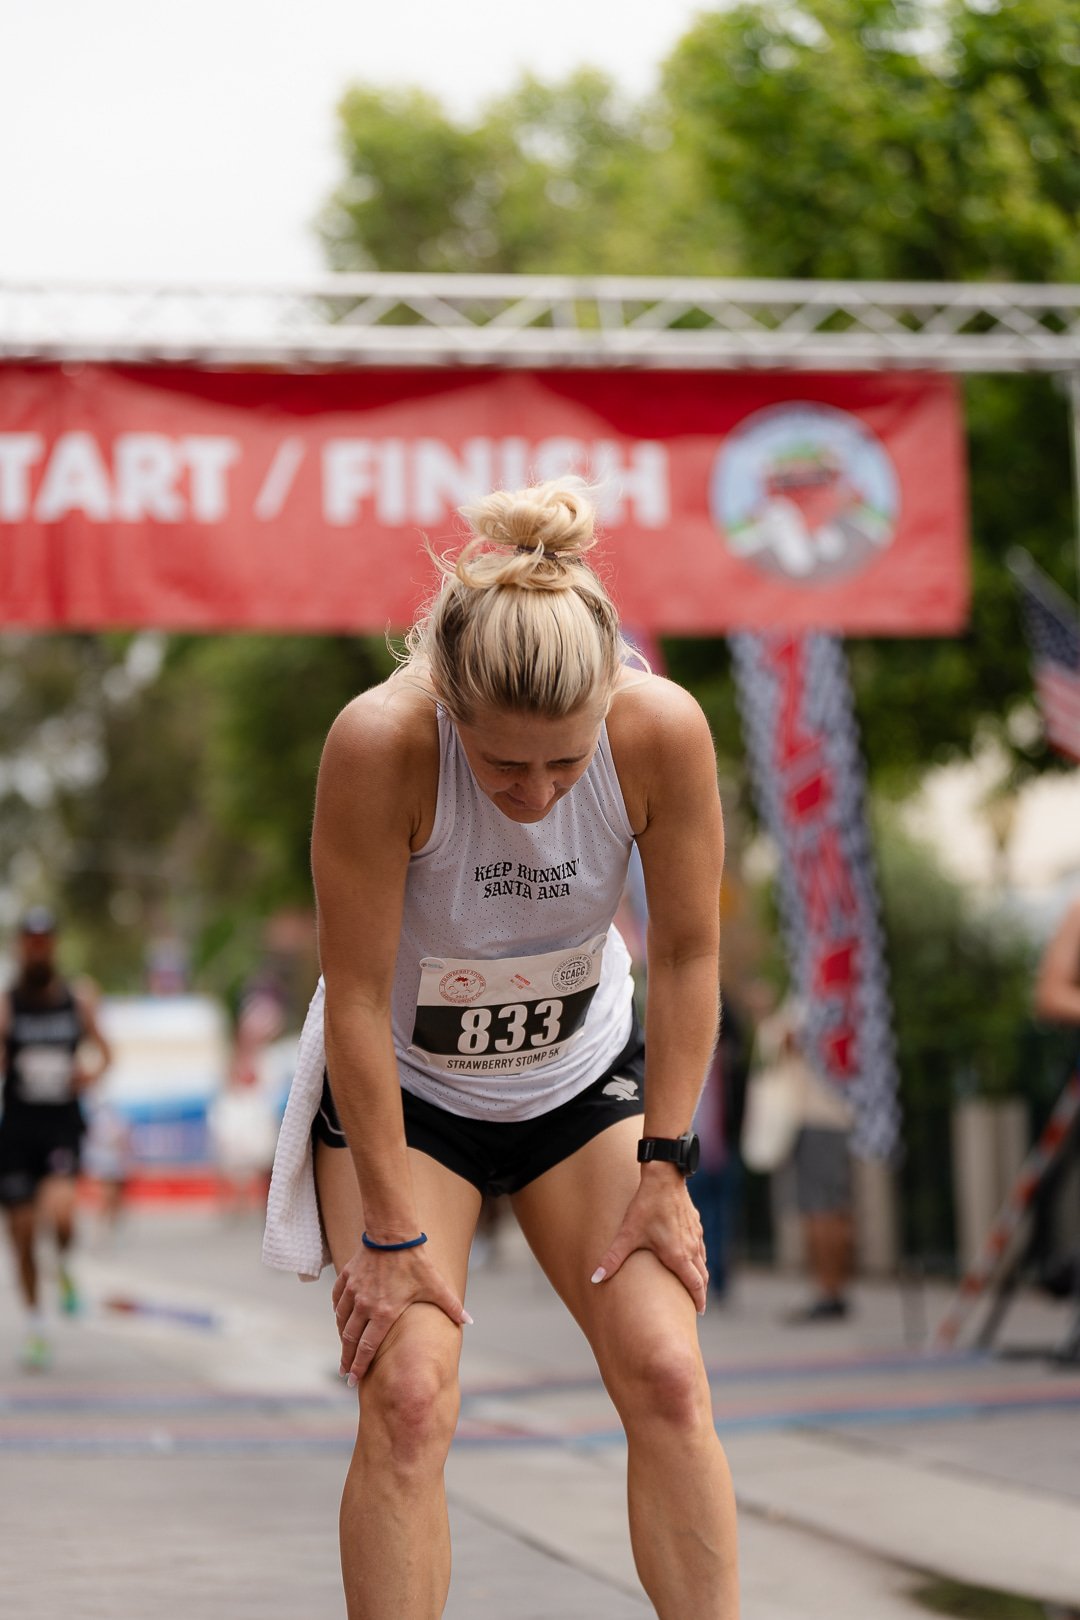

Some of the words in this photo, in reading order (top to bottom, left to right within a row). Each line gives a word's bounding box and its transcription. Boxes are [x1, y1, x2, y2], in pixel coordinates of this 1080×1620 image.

[253, 435, 305, 522] /
[474, 862, 513, 882] KEEP
[517, 858, 580, 883] RUNNIN'
[483, 880, 532, 900] SANTA
[537, 883, 571, 900] ANA
[560, 966, 586, 981] SCAGG
[457, 1000, 563, 1055] 833
[447, 1058, 514, 1070] STRAWBERRY
[515, 1052, 547, 1067] STOMP
[548, 1047, 560, 1059] 5K
